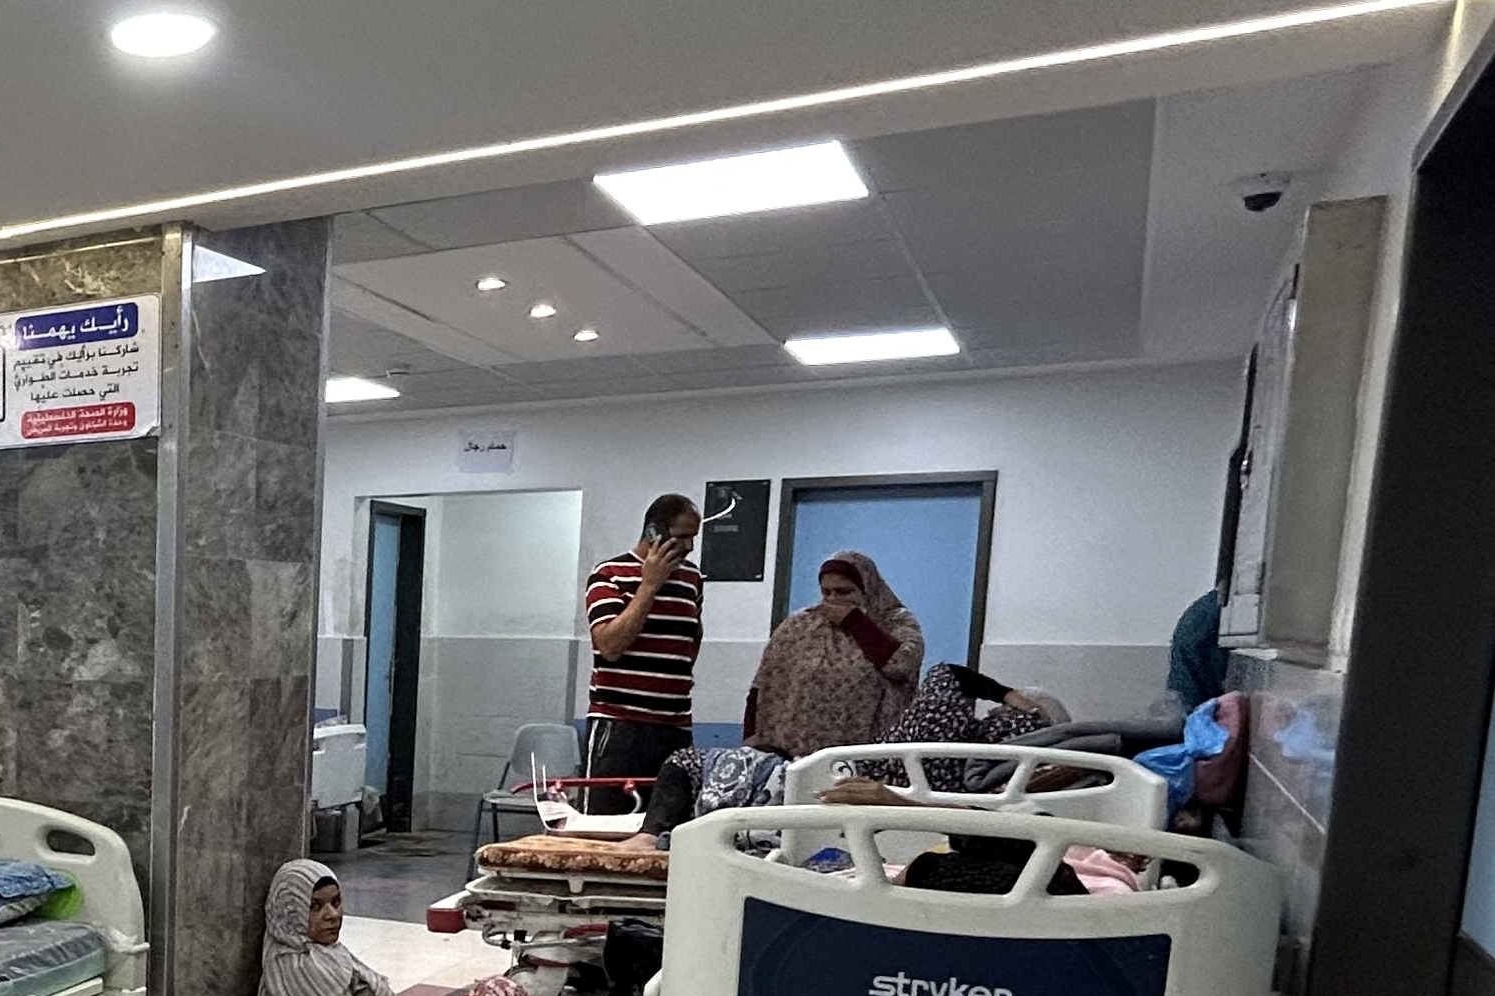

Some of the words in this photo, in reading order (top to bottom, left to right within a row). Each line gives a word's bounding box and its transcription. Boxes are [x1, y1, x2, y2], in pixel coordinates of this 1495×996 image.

[80, 305, 129, 335] رأيك
[22, 324, 76, 340] يهمنا
[65, 345, 96, 362] برأيك
[98, 341, 139, 357] شاركنا
[13, 353, 45, 371] تقييم
[47, 350, 63, 369] في
[58, 366, 99, 380] خدمات
[102, 361, 139, 377] تجربة
[30, 390, 59, 404] عليها
[62, 387, 96, 398] حصلت
[99, 383, 120, 401] التي
